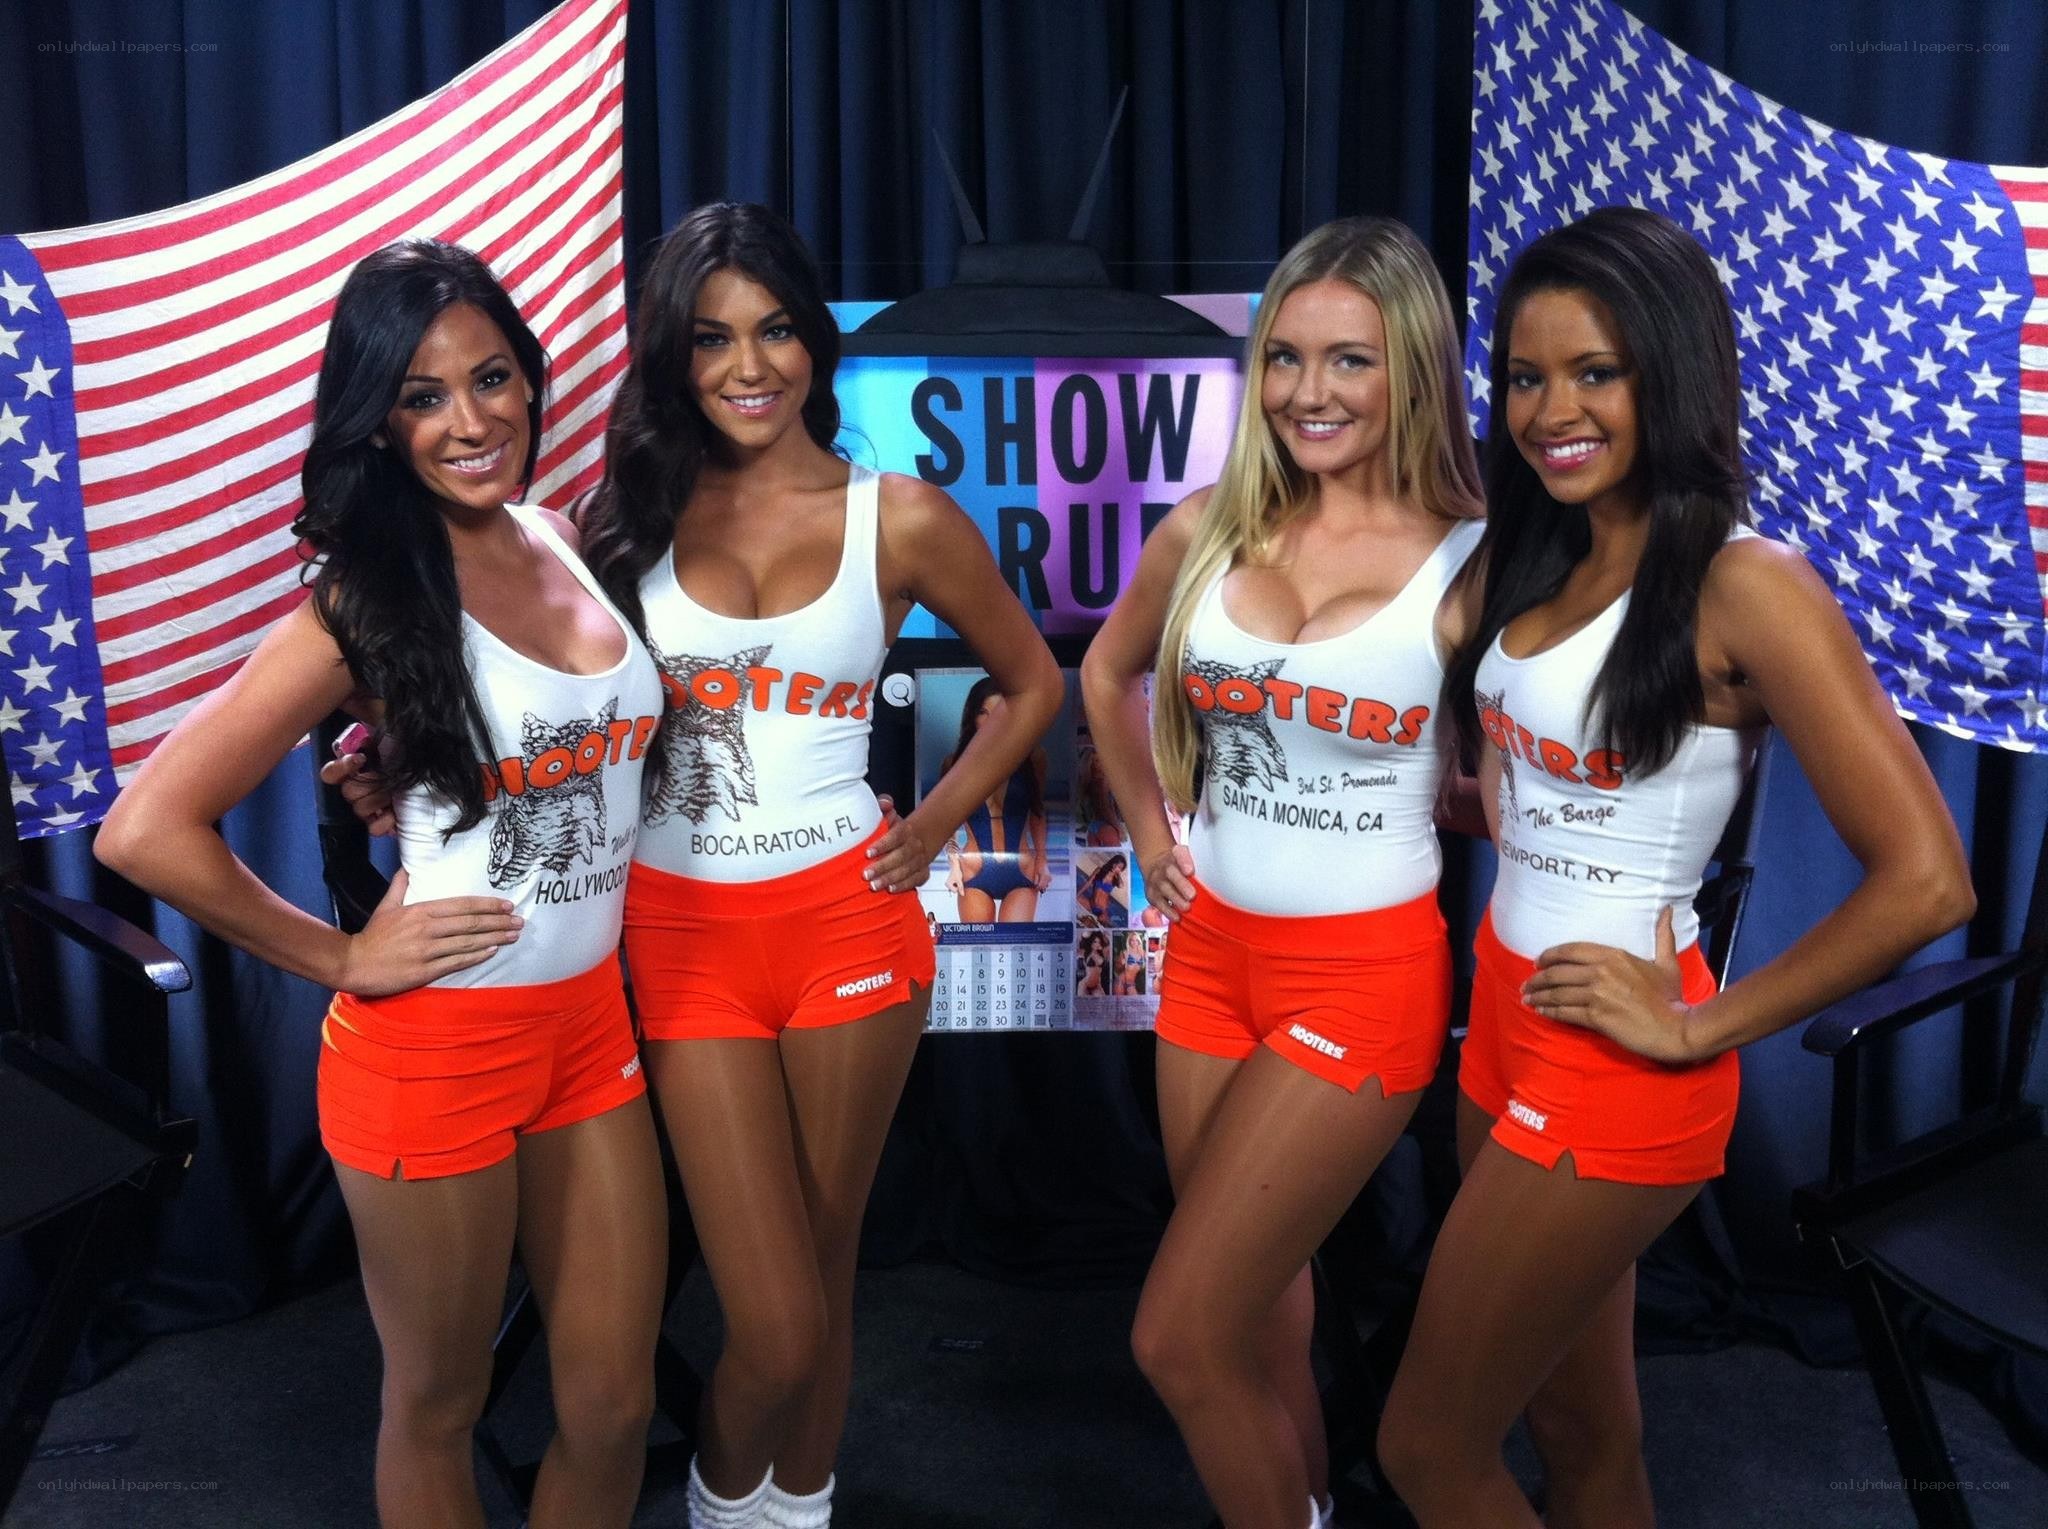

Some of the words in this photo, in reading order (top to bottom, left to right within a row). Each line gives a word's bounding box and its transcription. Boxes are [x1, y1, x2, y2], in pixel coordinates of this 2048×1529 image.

[911, 374, 1201, 487] SHOW
[1297, 777, 1315, 795] 3rd
[1341, 768, 1397, 792] Promenade
[1223, 785, 1267, 821] SANTA
[1273, 801, 1348, 835] MONICA,
[1356, 812, 1383, 831] CA
[1525, 807, 1554, 829] The
[1560, 803, 1615, 826] Barge
[691, 834, 749, 856] BOCA
[754, 824, 831, 854] RATON,
[835, 815, 860, 838] FL
[1586, 865, 1623, 883] KY
[998, 953, 1004, 963] 2
[1018, 953, 1024, 962] 3
[1037, 953, 1044, 962] 4
[1058, 953, 1063, 962] 5
[836, 971, 892, 998] HOOTERS
[938, 970, 946, 979] 6
[959, 969, 965, 979] 7
[978, 969, 985, 979] 8
[998, 969, 1004, 979] 9
[1017, 968, 1026, 978] 10
[1038, 968, 1044, 978] 11
[1056, 968, 1065, 978] 12
[938, 986, 947, 995] 13
[957, 986, 967, 994] 14
[977, 986, 986, 994] 15
[997, 985, 1007, 994] 16
[1017, 985, 1025, 994] 17
[1036, 984, 1046, 994] 18
[1056, 984, 1066, 993] 19
[936, 1001, 948, 1011] 20
[957, 1001, 966, 1010] 21
[976, 1001, 987, 1010] 22
[996, 1000, 1007, 1010] 23
[1015, 1000, 1026, 1009] 24
[1035, 1000, 1046, 1009] 25
[937, 1017, 947, 1027] 27
[956, 1017, 968, 1026] 28
[976, 1017, 988, 1026] 29
[995, 1016, 1008, 1026] 30
[1016, 1016, 1024, 1026] 31
[1288, 1023, 1346, 1060] HOOTERS
